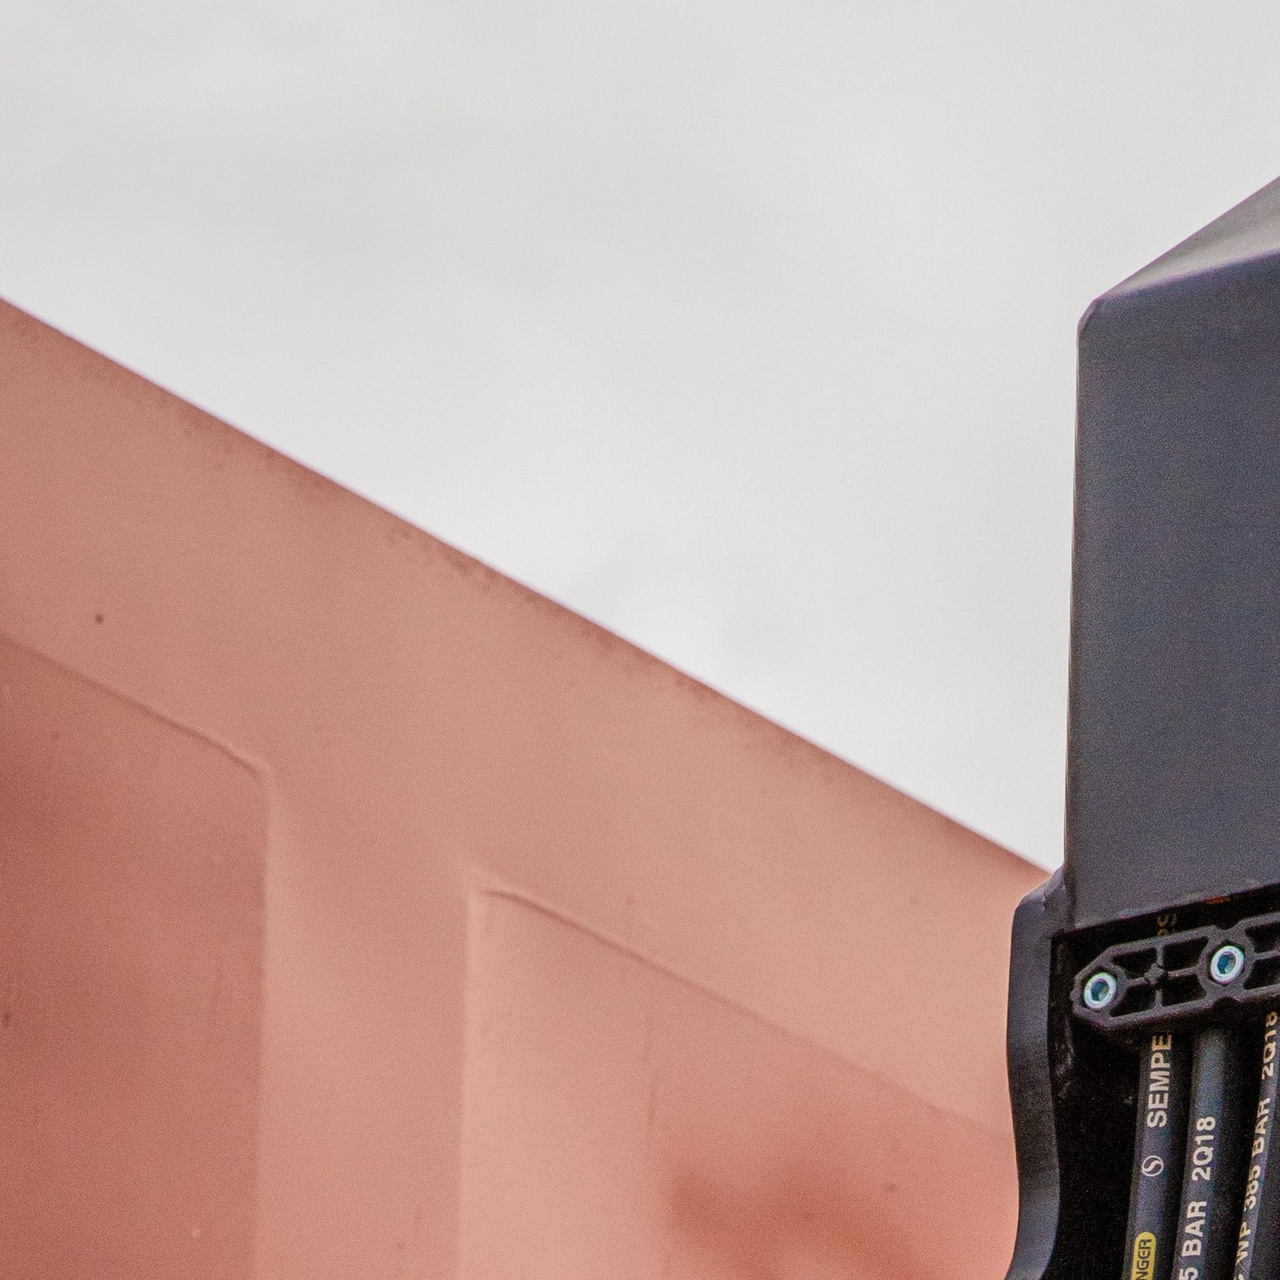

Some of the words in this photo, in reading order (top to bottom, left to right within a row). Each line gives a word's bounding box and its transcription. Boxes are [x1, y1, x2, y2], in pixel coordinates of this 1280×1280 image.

[1260, 1010, 1279, 1079] 2Q18
[1191, 1115, 1217, 1182] 2Q18
[1251, 1097, 1272, 1157] BAR
[1244, 1166, 1261, 1213] 385
[1182, 1200, 1207, 1258] BAR
[1234, 1222, 1251, 1267] WP
